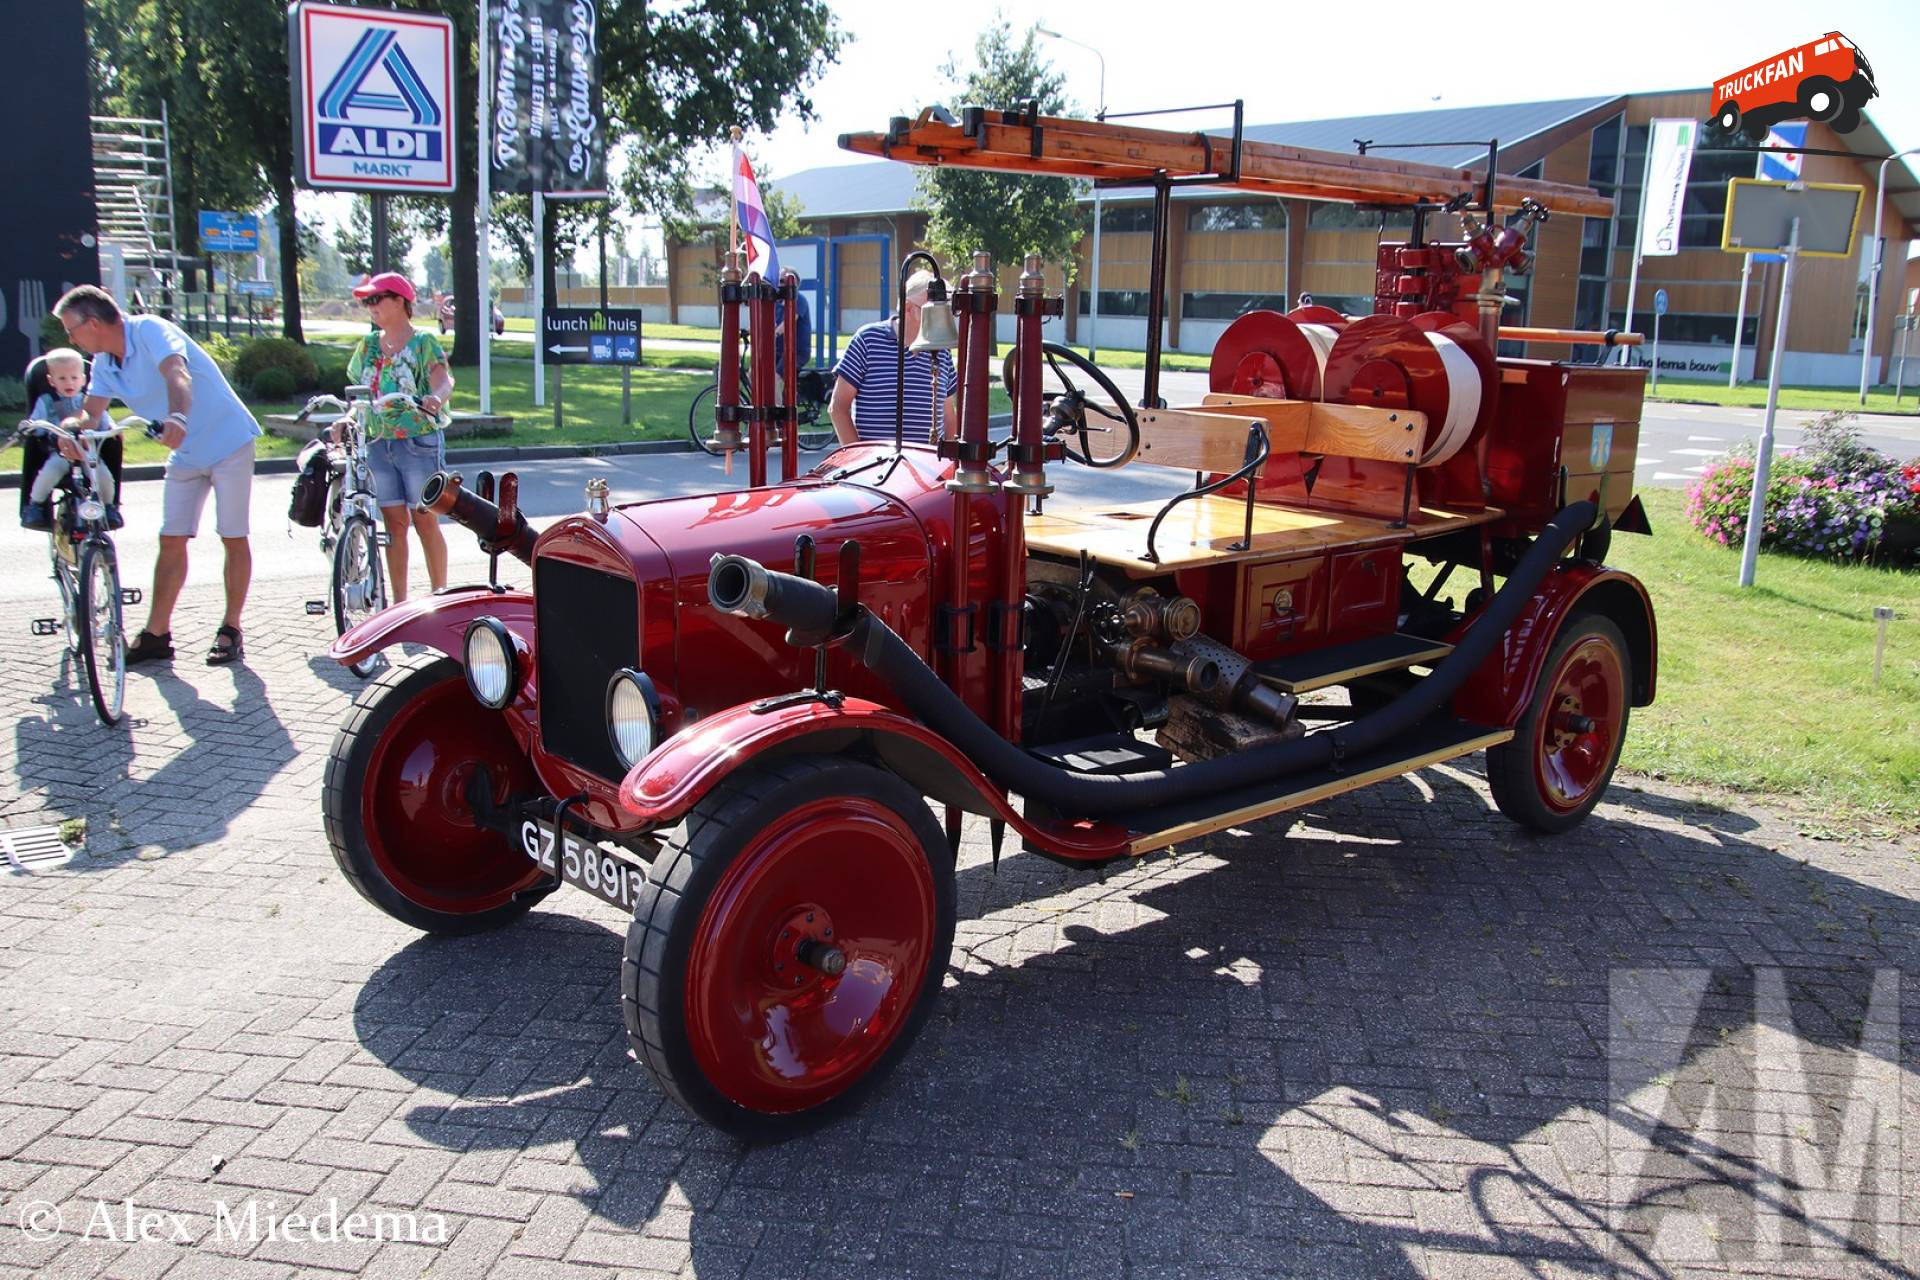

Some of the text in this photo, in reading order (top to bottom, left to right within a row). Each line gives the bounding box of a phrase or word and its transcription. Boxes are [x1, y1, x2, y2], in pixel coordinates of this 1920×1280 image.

[532, 64, 544, 82] EN
[494, 5, 525, 169] Lauwers
[567, 0, 597, 178] De Lauwers
[530, 85, 544, 138] EETHUIS
[329, 127, 428, 159] ALDI
[353, 161, 412, 176] MARKT
[547, 315, 638, 331] lunch huis
[1638, 355, 1719, 372] holema bouw
